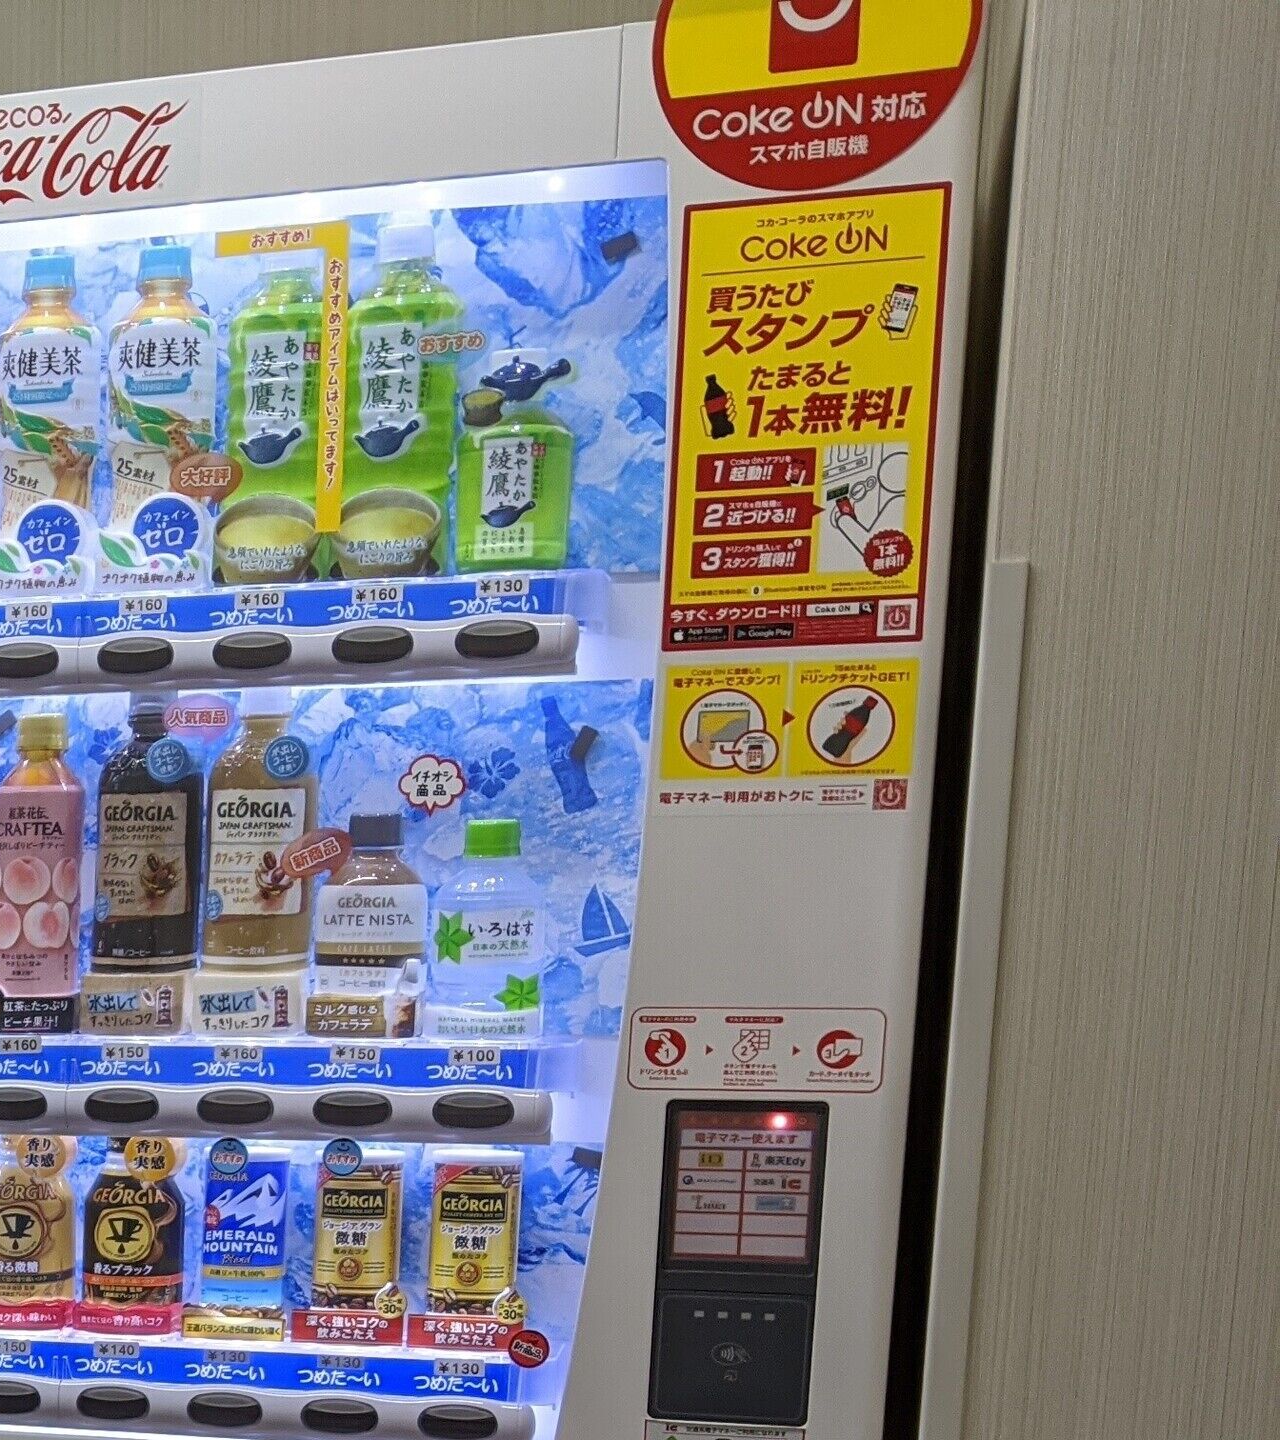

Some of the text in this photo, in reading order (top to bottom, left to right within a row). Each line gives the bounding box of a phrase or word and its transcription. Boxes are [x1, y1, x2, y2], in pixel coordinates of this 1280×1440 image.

[692, 91, 928, 141] Coke ON 対応
[749, 135, 869, 165] スマホ自販機
[740, 223, 888, 262] Coke ON
[707, 279, 814, 314] 買うたび
[702, 304, 874, 356] スタンプ
[119, 337, 201, 371] 爽健美茶
[418, 333, 486, 355] おすすめ
[3, 346, 83, 379] 爽健美茶
[363, 336, 395, 411] 綾鷹
[397, 326, 417, 412] あやたか
[247, 344, 280, 418] 綾鷹
[280, 336, 300, 420] あやたか
[747, 361, 852, 391] たまると
[181, 467, 231, 488] 大好評
[486, 449, 513, 498] 綾鷹
[512, 441, 528, 502] あやたか
[714, 460, 724, 483] 1
[26, 516, 70, 528] カフェイン
[142, 510, 190, 524] カフェイン
[703, 503, 725, 528] 2
[25, 528, 66, 552] ゼロ
[140, 523, 184, 547] ゼロ
[700, 547, 722, 571] 3
[356, 588, 397, 601] ¥160
[480, 579, 523, 593] ¥130
[125, 599, 163, 611] ¥160
[241, 593, 279, 605] ¥160
[11, 606, 48, 617] ¥160
[168, 708, 229, 727] 人気商品
[104, 800, 177, 822] GEORGIA
[292, 838, 341, 870] 新商品
[324, 914, 414, 926] LATTE NISTA
[318, 1019, 373, 1030] カフェラテ
[106, 1046, 144, 1059] ¥150
[335, 1048, 376, 1061] ¥150
[453, 1049, 495, 1063] ¥100
[324, 1190, 383, 1208] GEORGIA
[443, 1194, 503, 1211] GEORGIA
[206, 1230, 275, 1243] EMERALD
[335, 1231, 366, 1245] 微糖
[203, 1242, 278, 1255] MOUNTAIN
[99, 1344, 134, 1355] ¥140
[439, 1362, 479, 1375] ¥130
